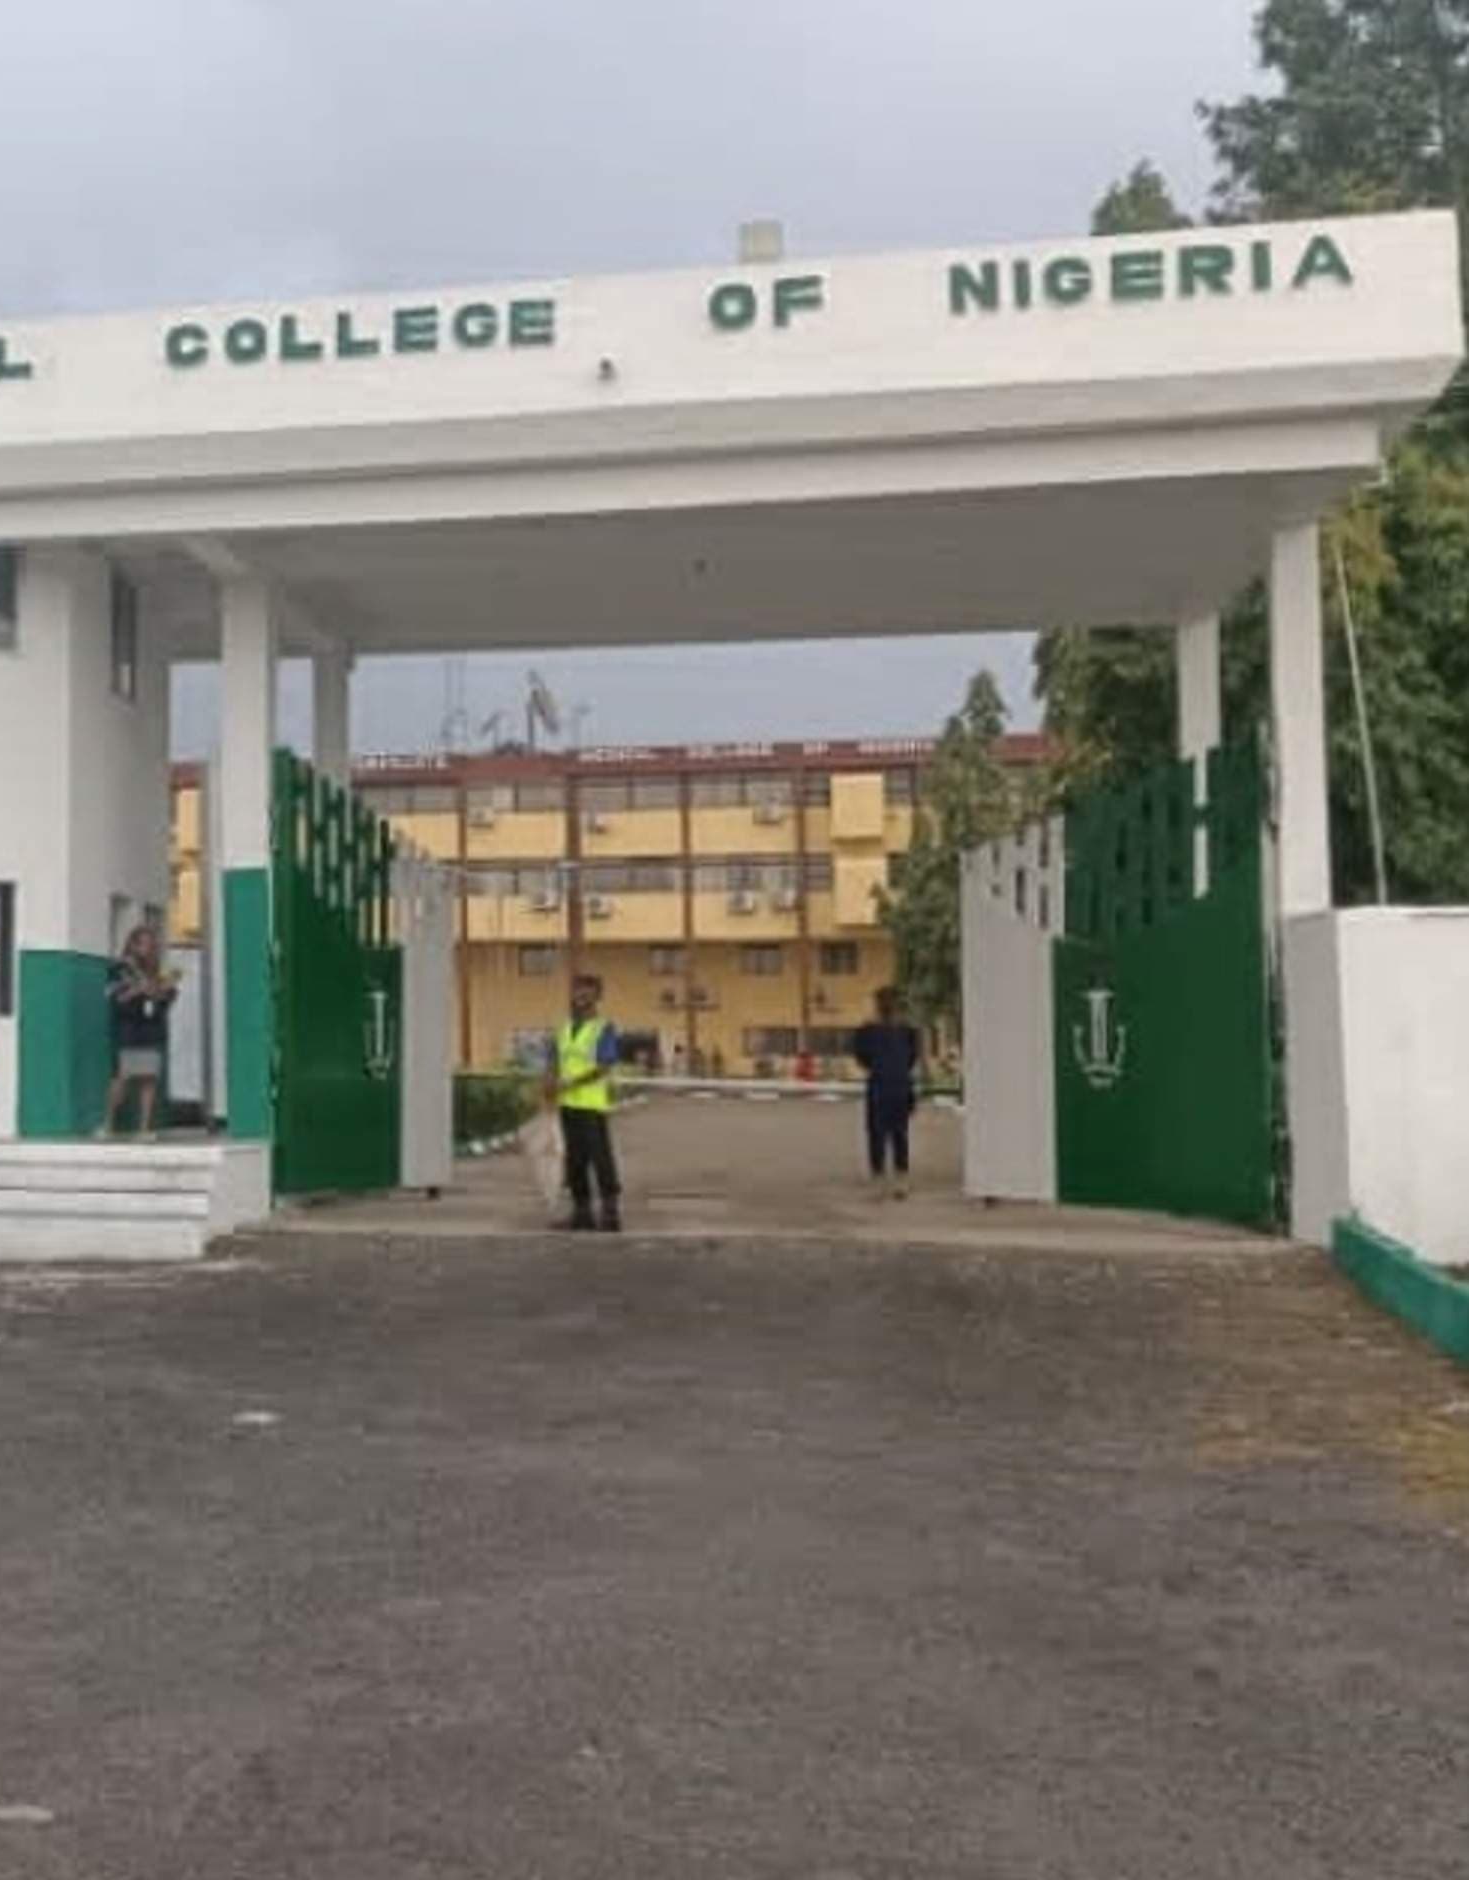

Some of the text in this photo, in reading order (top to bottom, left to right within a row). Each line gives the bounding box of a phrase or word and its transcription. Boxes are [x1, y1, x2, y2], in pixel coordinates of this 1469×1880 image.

[165, 299, 557, 369] COLLEGE
[708, 275, 826, 332] OF
[949, 235, 1353, 315] NIGERIA
